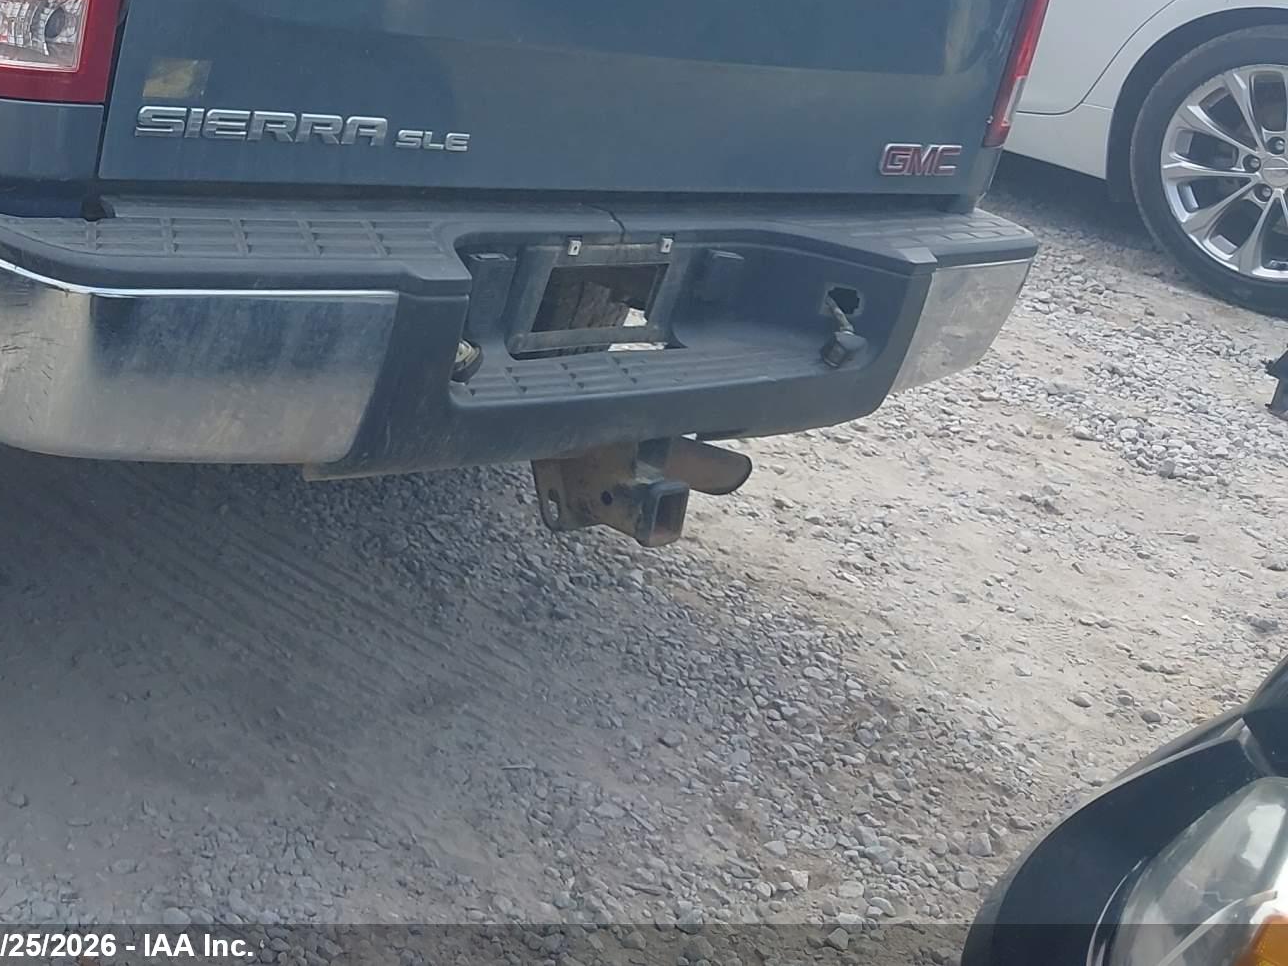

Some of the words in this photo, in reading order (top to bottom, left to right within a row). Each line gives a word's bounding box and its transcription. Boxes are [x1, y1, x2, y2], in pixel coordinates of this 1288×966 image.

[135, 104, 389, 146] SIERRA
[395, 128, 471, 153] SLE
[880, 142, 962, 176] GMC
